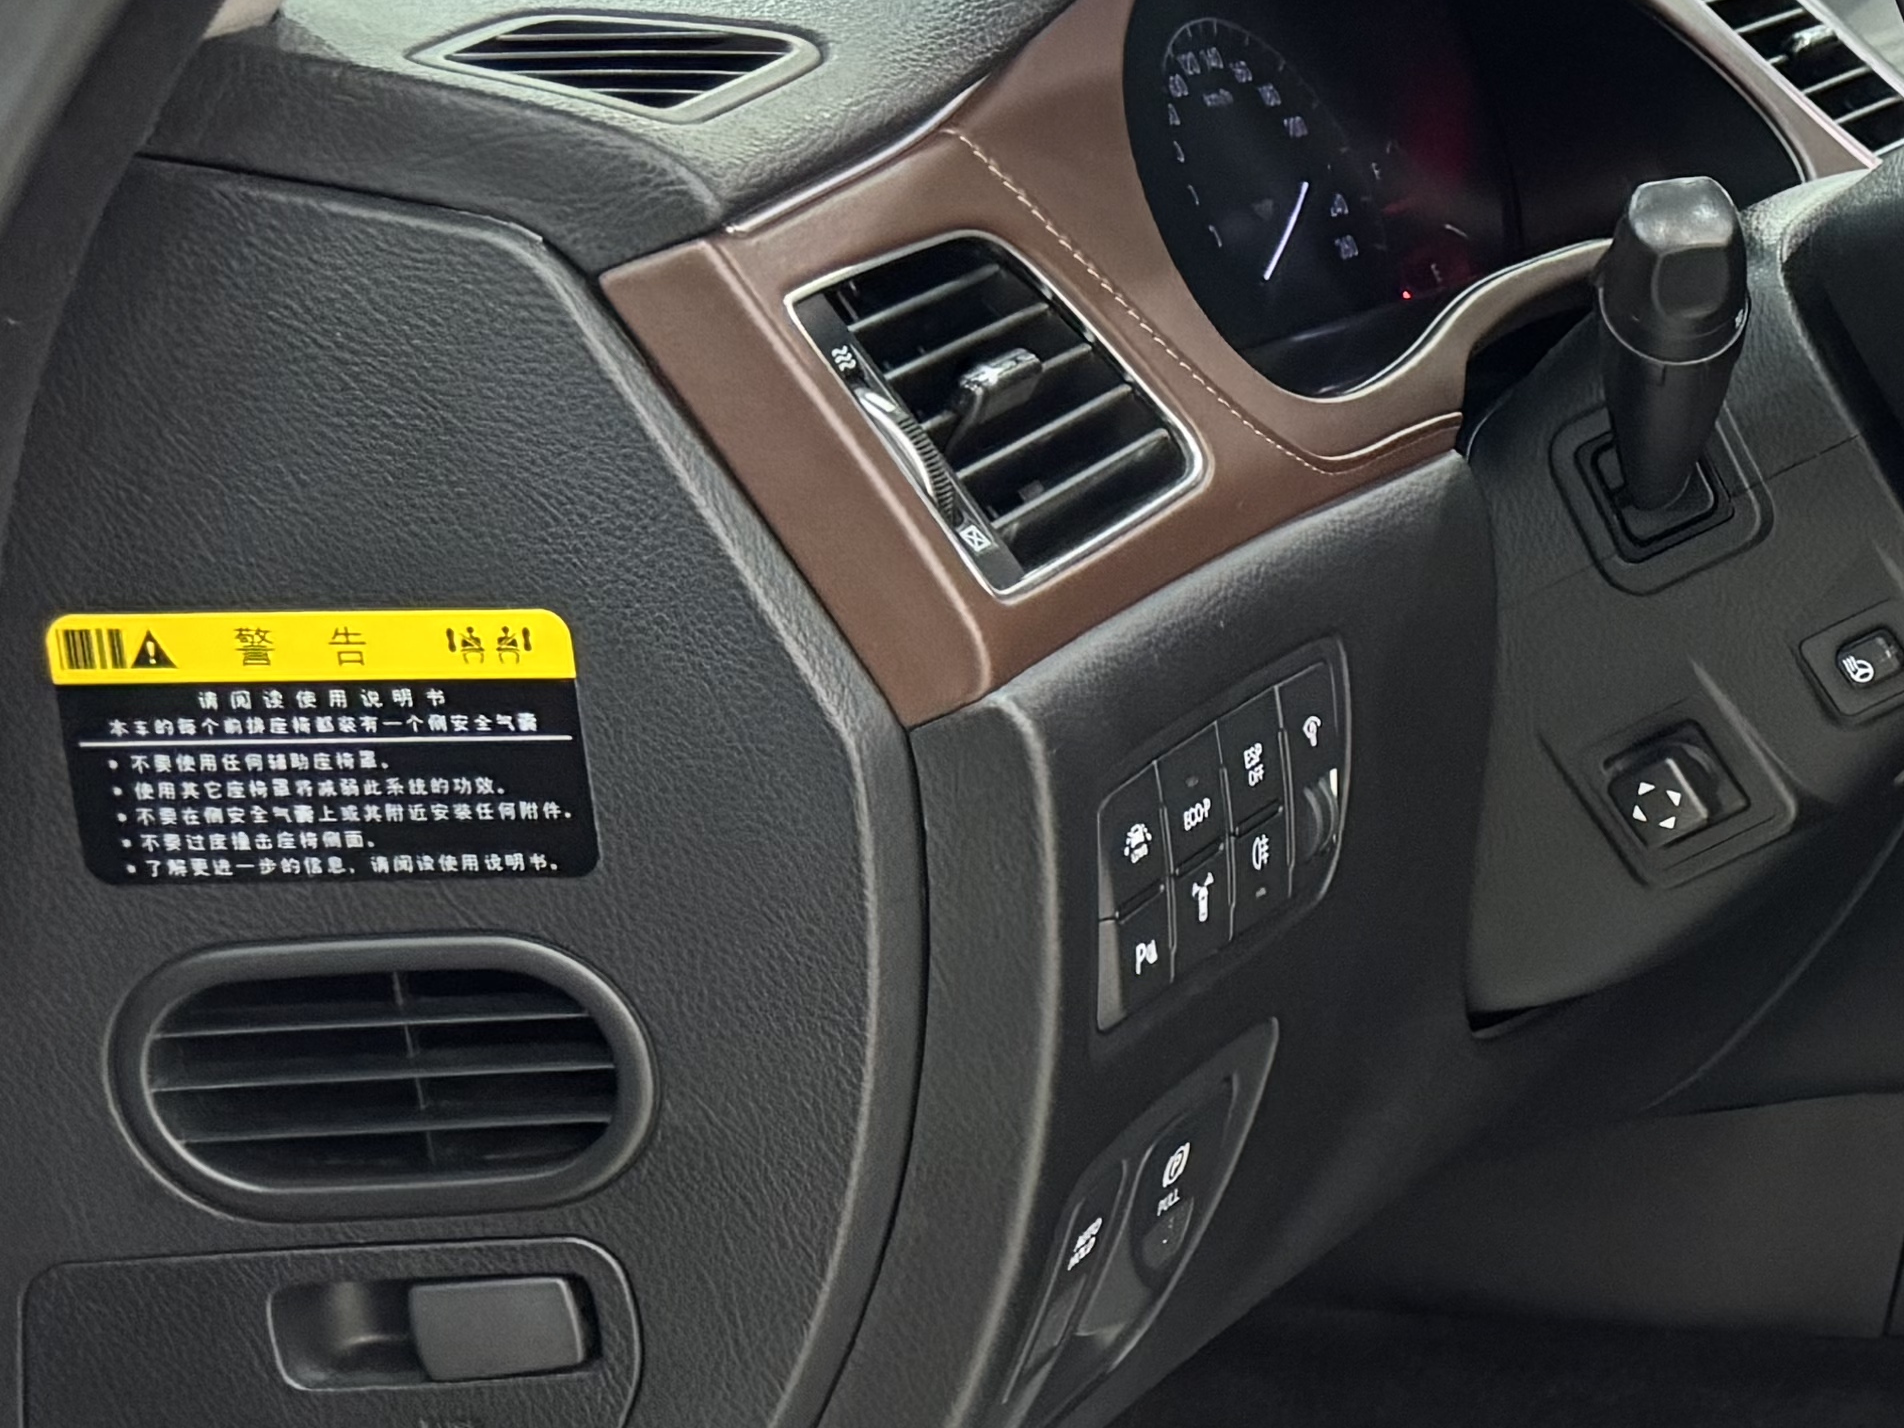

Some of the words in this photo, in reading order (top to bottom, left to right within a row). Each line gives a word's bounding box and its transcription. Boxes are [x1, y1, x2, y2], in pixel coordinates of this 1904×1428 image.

[233, 627, 368, 668] 警告
[198, 688, 447, 711] 请阅读使用说明书
